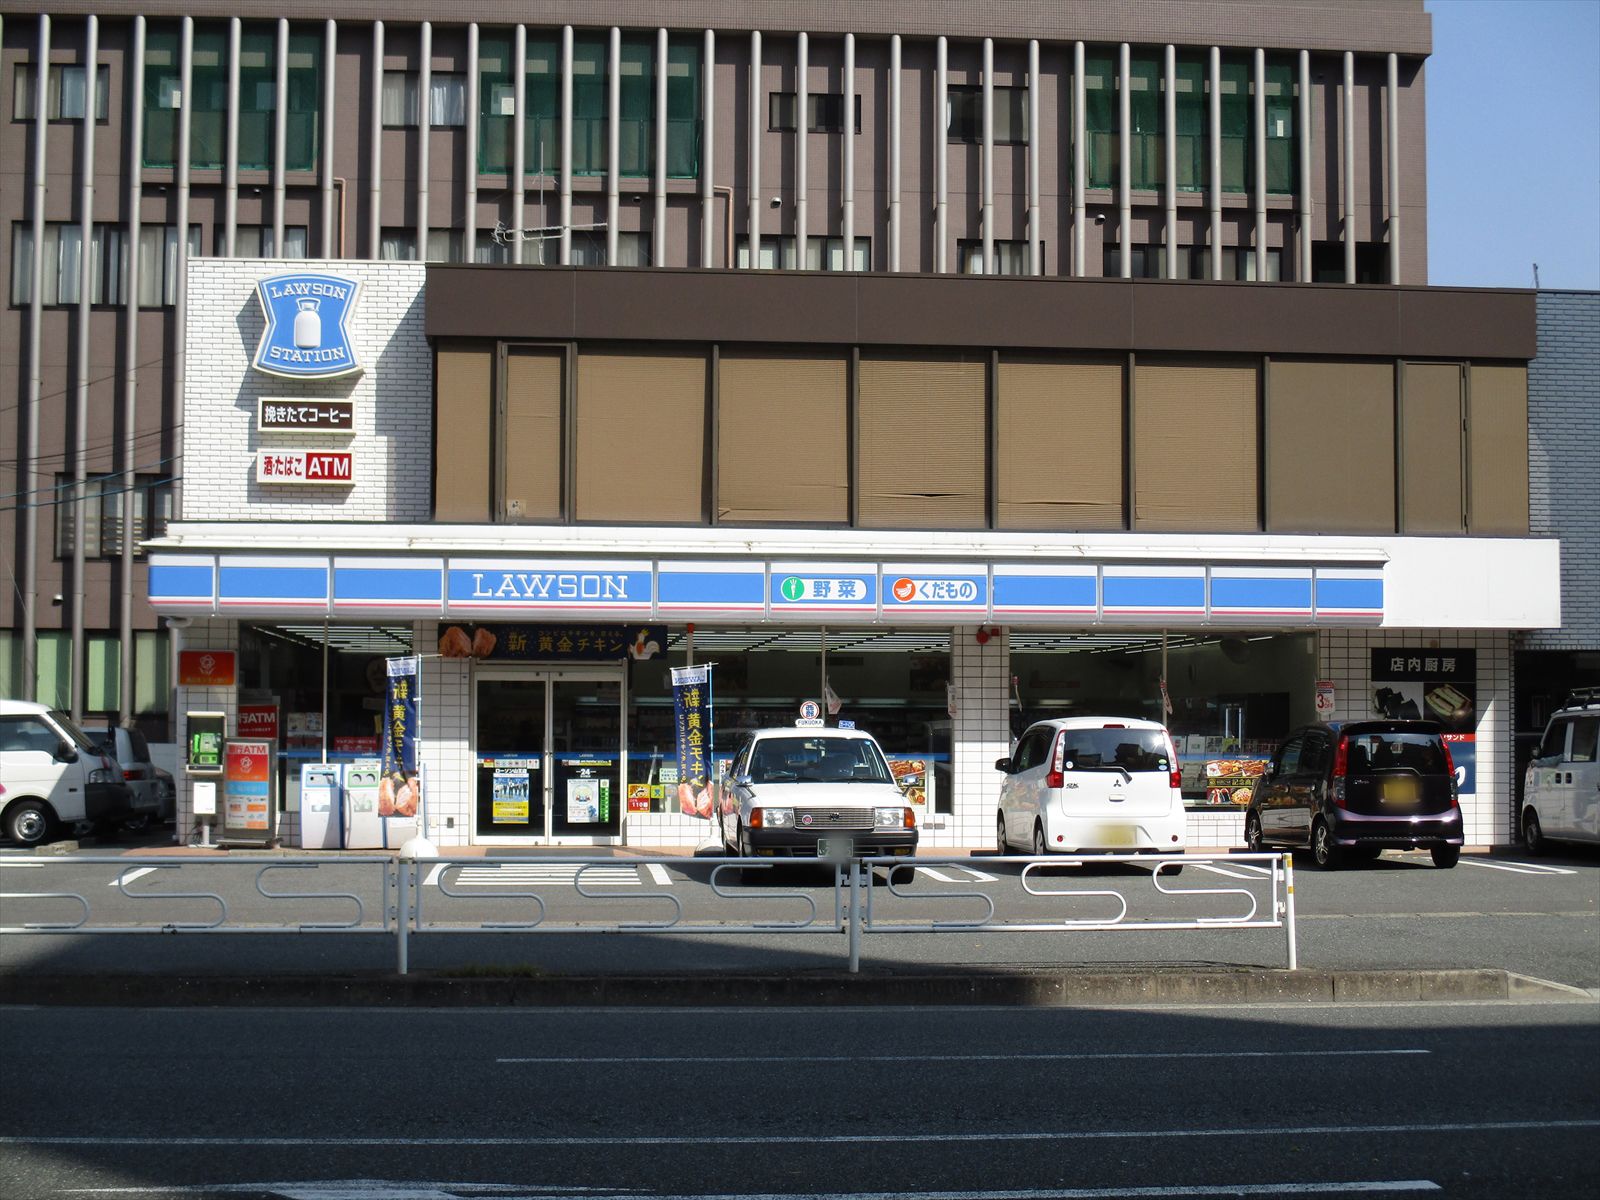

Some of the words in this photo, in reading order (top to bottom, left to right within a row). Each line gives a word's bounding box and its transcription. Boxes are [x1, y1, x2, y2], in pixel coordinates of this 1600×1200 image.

[270, 283, 347, 300] LAWSON
[270, 346, 346, 363] STATION
[264, 406, 350, 424] 挽きたてコーヒー
[308, 457, 349, 477] ATM
[471, 573, 628, 599] LAWSON
[812, 580, 856, 598] 野菜
[919, 582, 973, 599] くだもの
[537, 635, 624, 653] 黄金チキン
[1390, 656, 1456, 673] 店内厨房
[580, 768, 591, 776] 24
